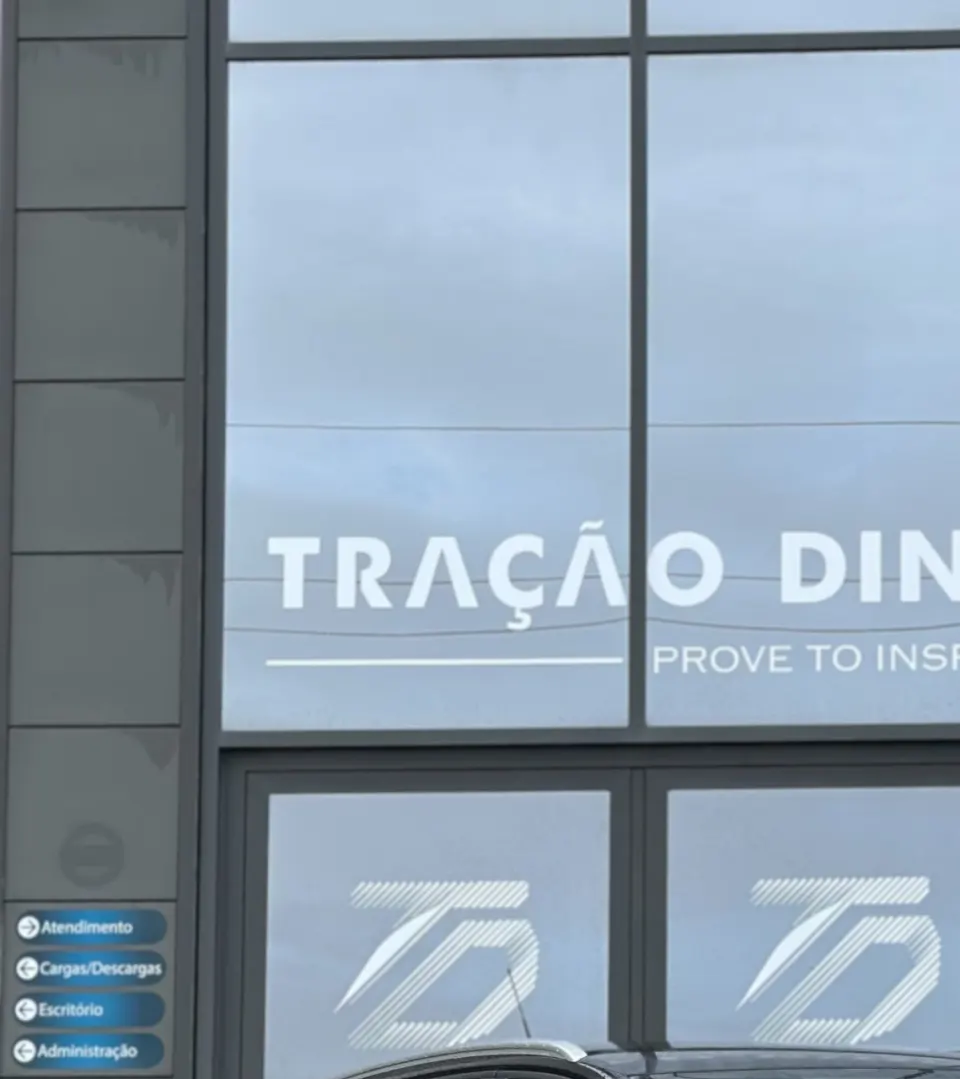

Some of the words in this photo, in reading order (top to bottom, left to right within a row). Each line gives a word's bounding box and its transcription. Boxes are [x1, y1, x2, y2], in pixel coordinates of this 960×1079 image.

[267, 520, 724, 631] TRAÇÃO
[652, 644, 793, 674] PROVE
[805, 643, 863, 673] TO
[41, 920, 133, 936] Atendimento
[40, 961, 162, 979] Cargas/Descargas
[38, 1002, 104, 1018] Escritório
[37, 1043, 138, 1061] Administração
